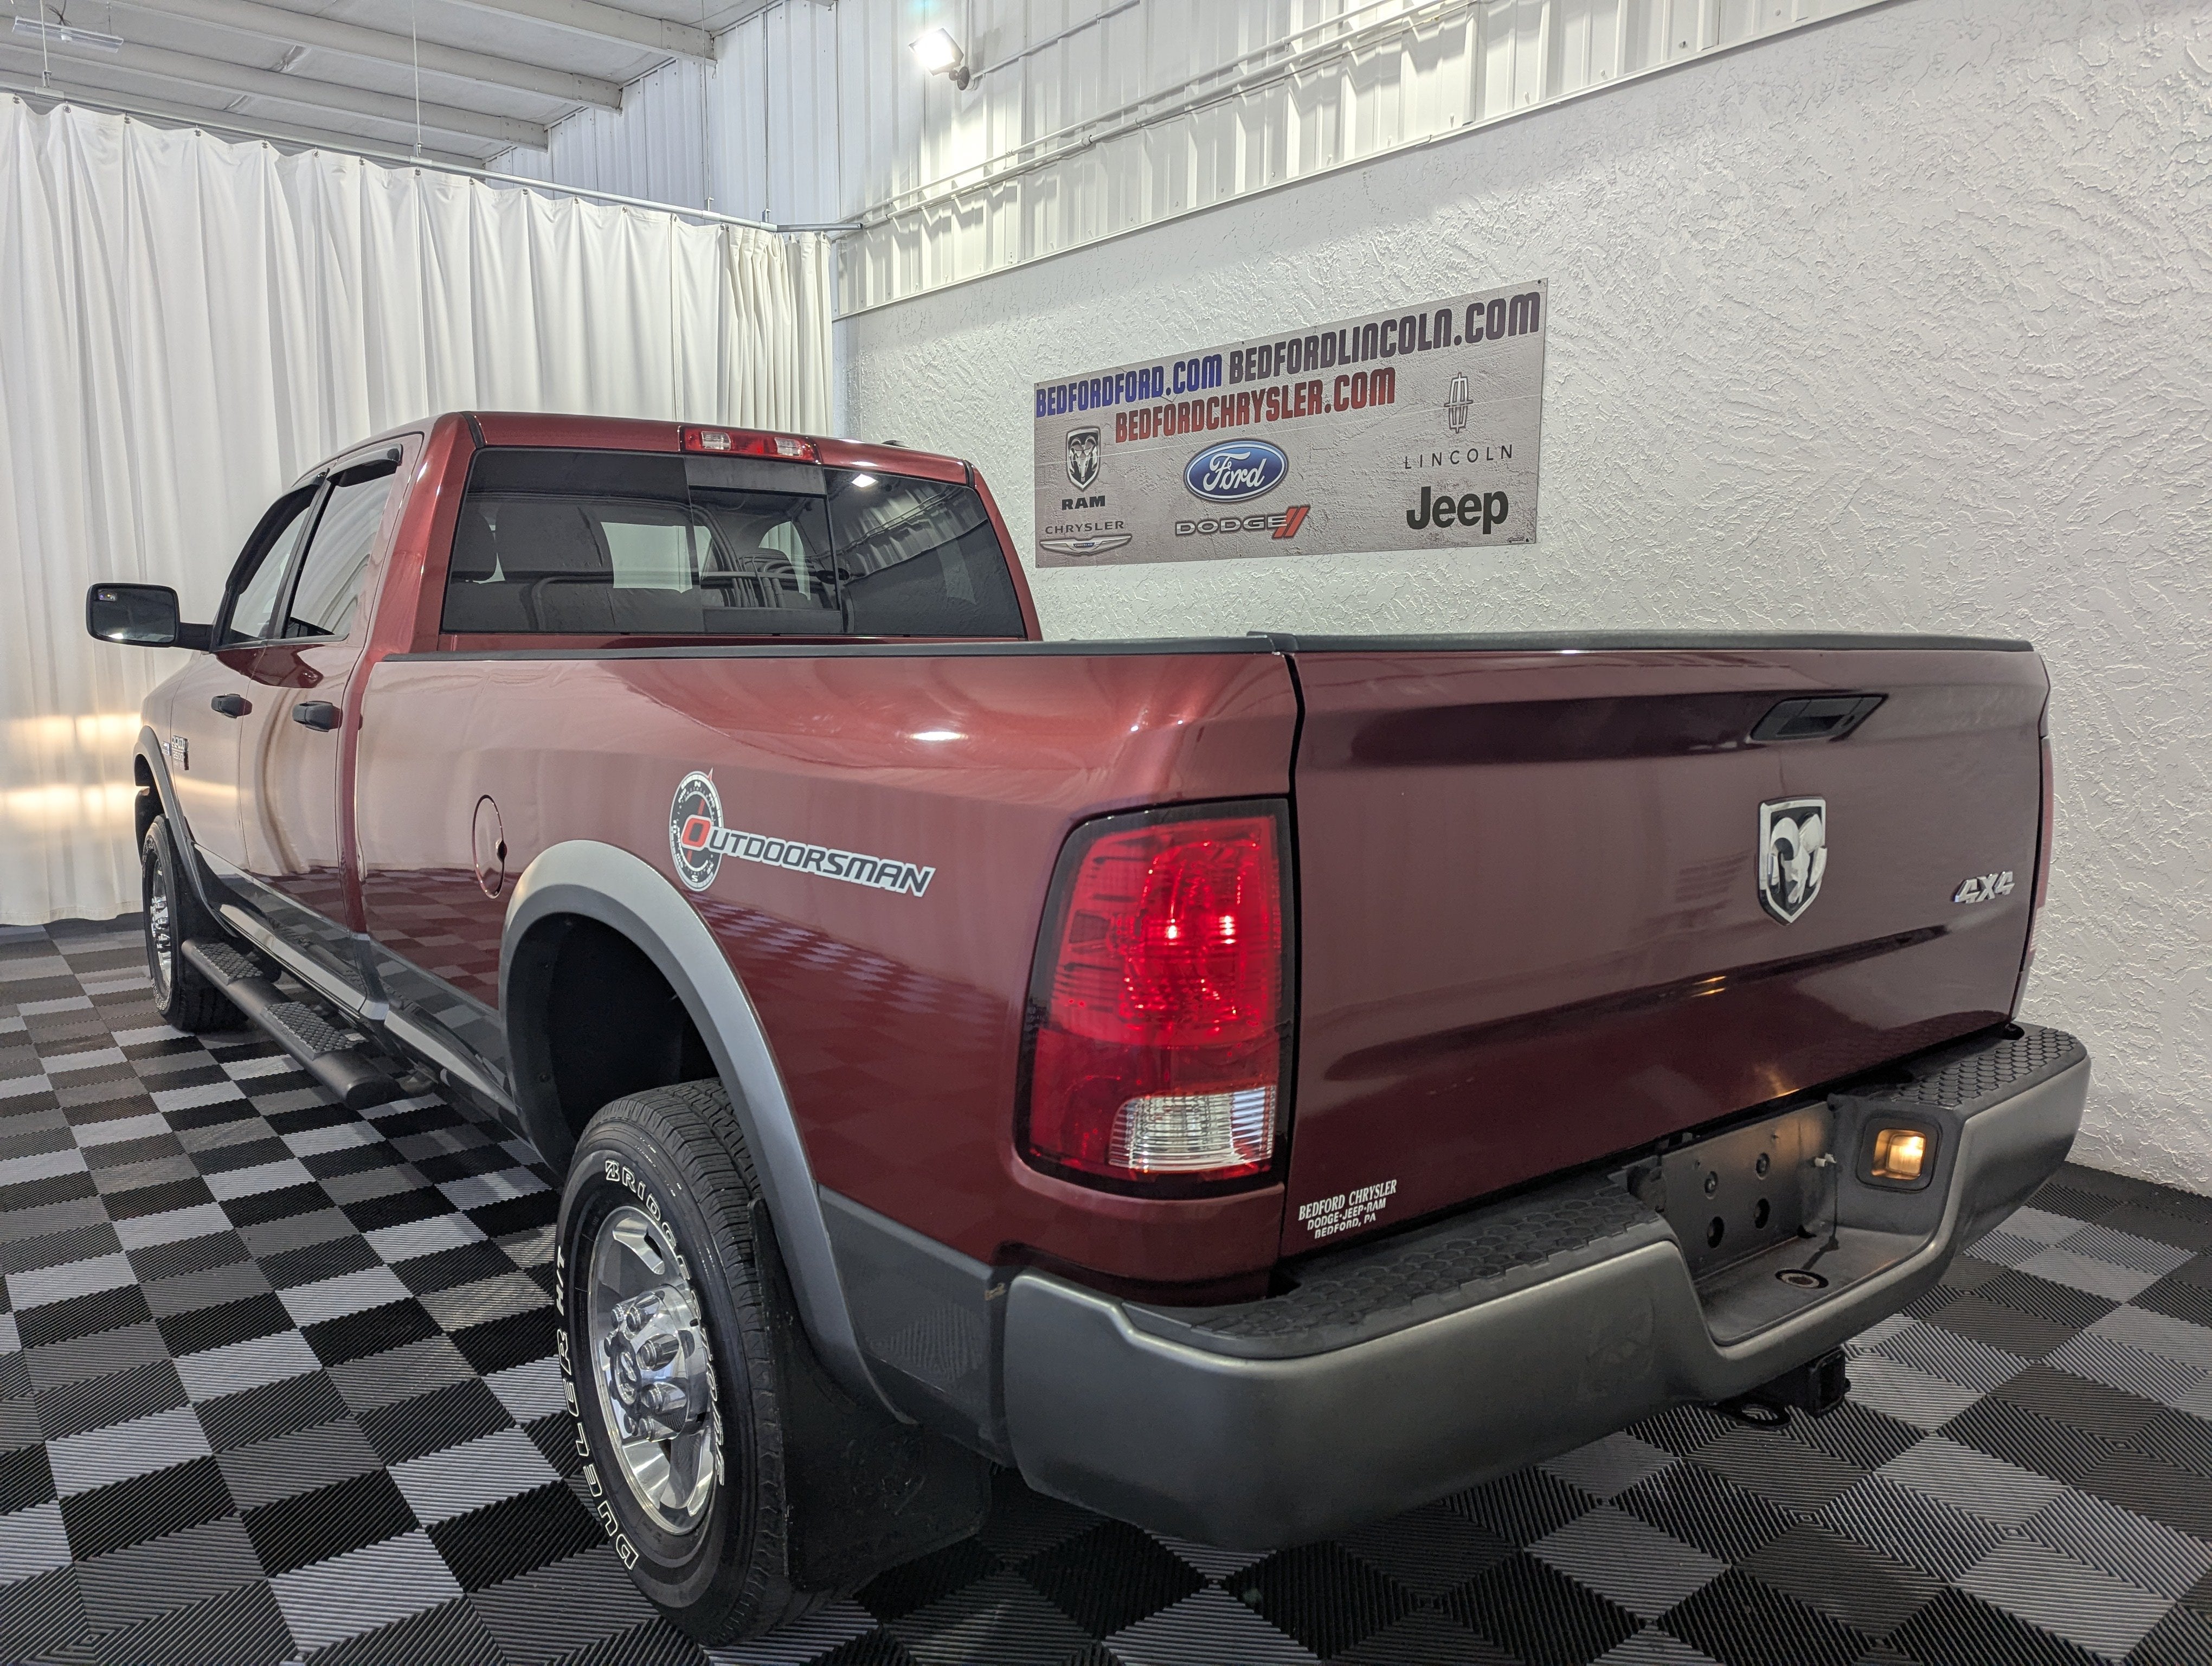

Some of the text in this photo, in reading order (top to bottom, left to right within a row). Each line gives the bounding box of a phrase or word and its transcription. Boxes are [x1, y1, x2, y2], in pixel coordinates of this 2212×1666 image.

[1037, 292, 1541, 418] BEDFORDFORD.COM BEDFORDLINCOLN.COM
[1116, 367, 1396, 443] BEDFORDCHRYSLER.COM
[1203, 452, 1266, 491] Ford
[1405, 444, 1512, 469] LINCOLN
[1062, 496, 1105, 510] RAM
[1406, 486, 1509, 534] Jeep
[1045, 521, 1124, 534] CHRYSLER
[1176, 515, 1287, 535] DODGE
[681, 815, 934, 895] OUTDOORSMAN
[1954, 871, 2015, 904] 4X4
[1298, 1179, 1397, 1221] BEDFORD CHRYSLER
[1314, 1213, 1376, 1239] BEDFORD, PA
[557, 1328, 639, 1571] DUELER
